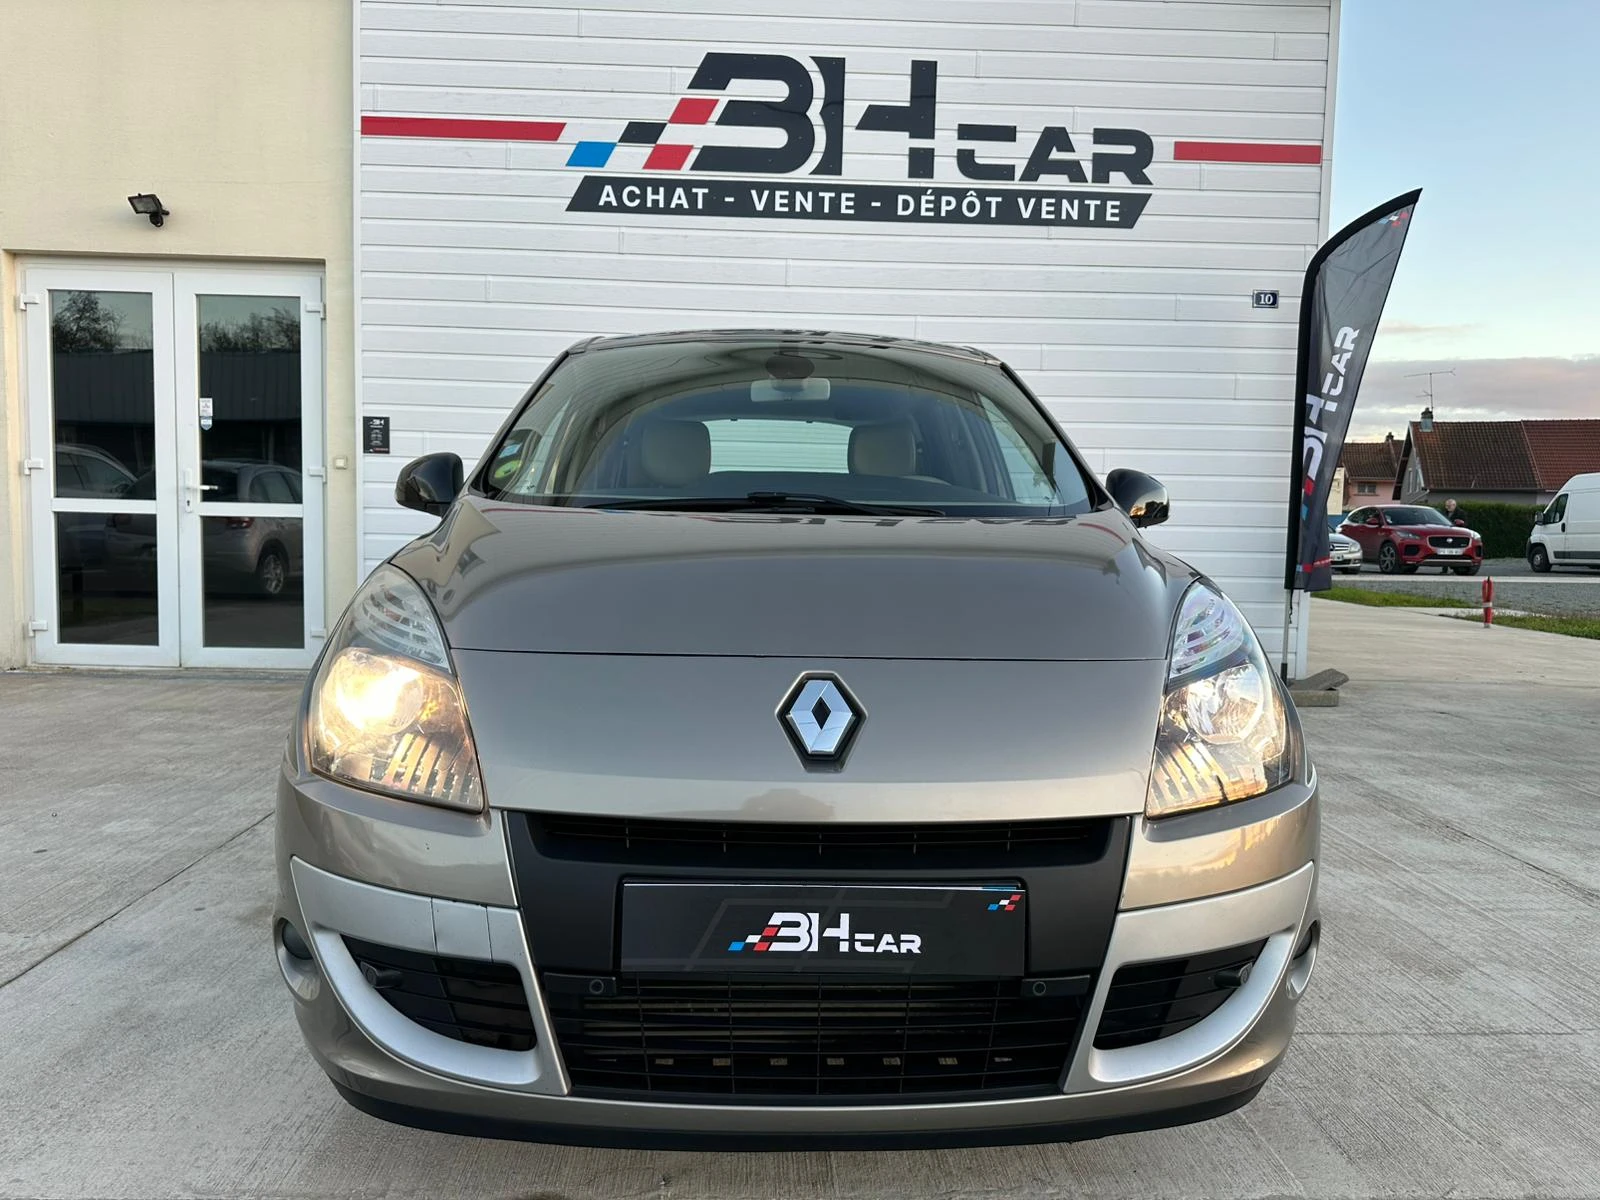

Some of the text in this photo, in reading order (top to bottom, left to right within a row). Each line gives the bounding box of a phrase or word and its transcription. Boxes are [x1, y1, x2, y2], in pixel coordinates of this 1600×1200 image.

[598, 184, 709, 210] ACHAT
[750, 188, 856, 215] VENTE
[896, 189, 1003, 218] DÉPÔT
[1016, 196, 1121, 222] VENTE
[1259, 293, 1274, 305] 10
